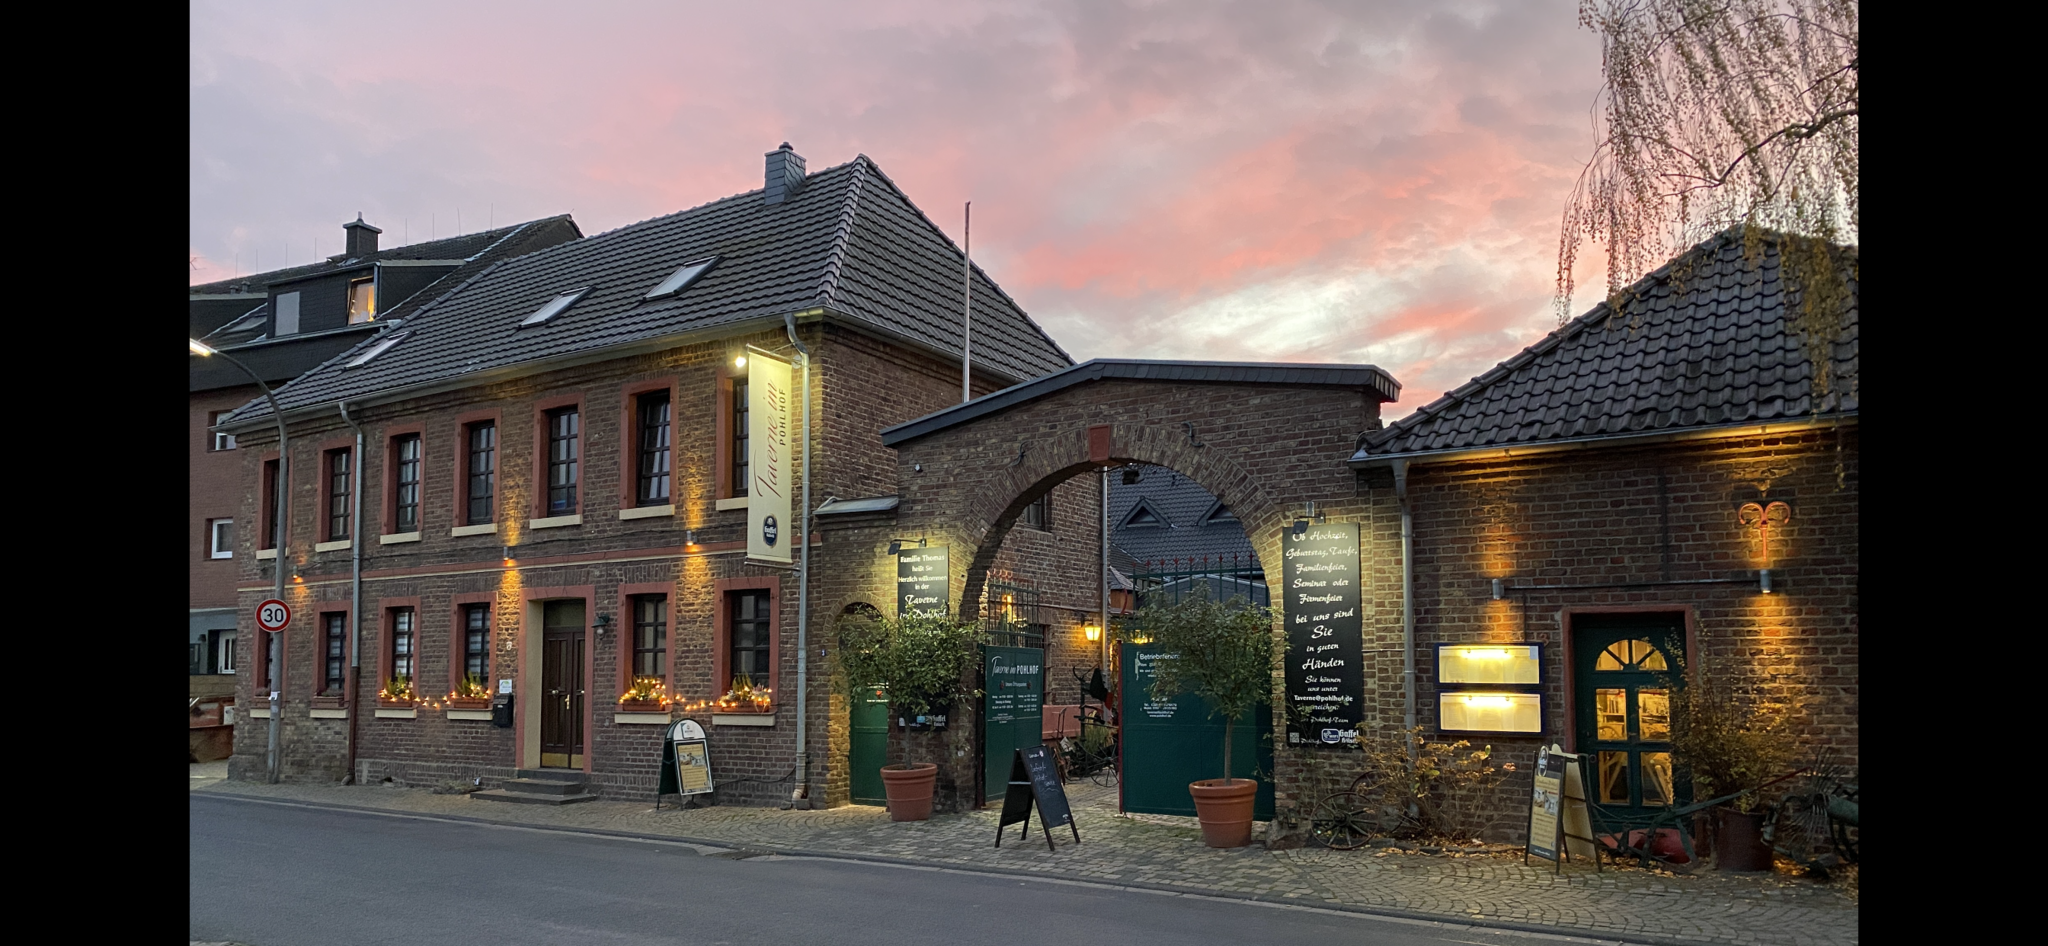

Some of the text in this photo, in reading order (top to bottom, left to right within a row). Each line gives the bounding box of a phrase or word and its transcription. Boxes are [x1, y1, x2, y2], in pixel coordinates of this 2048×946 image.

[754, 379, 782, 498] Taverne im
[1310, 530, 1348, 541] Hochzeit,
[1286, 546, 1357, 559] Geburtstag, Taufe,
[1295, 562, 1347, 574] Familienfeier,
[1292, 578, 1349, 588] Seminar oder
[904, 594, 939, 604] Taverne
[1299, 593, 1343, 604] Firmenfeier
[263, 608, 284, 623] 30
[1295, 607, 1354, 624] bei uns sind
[1310, 625, 1333, 639] Sie
[1317, 644, 1339, 653] guten
[1301, 657, 1345, 670] Händen
[1016, 665, 1039, 674] POHLHOF
[1305, 674, 1342, 684] Sie können
[1293, 694, 1354, 702] Taverne@pohlhof.de
[1339, 729, 1359, 738] Gaffel
